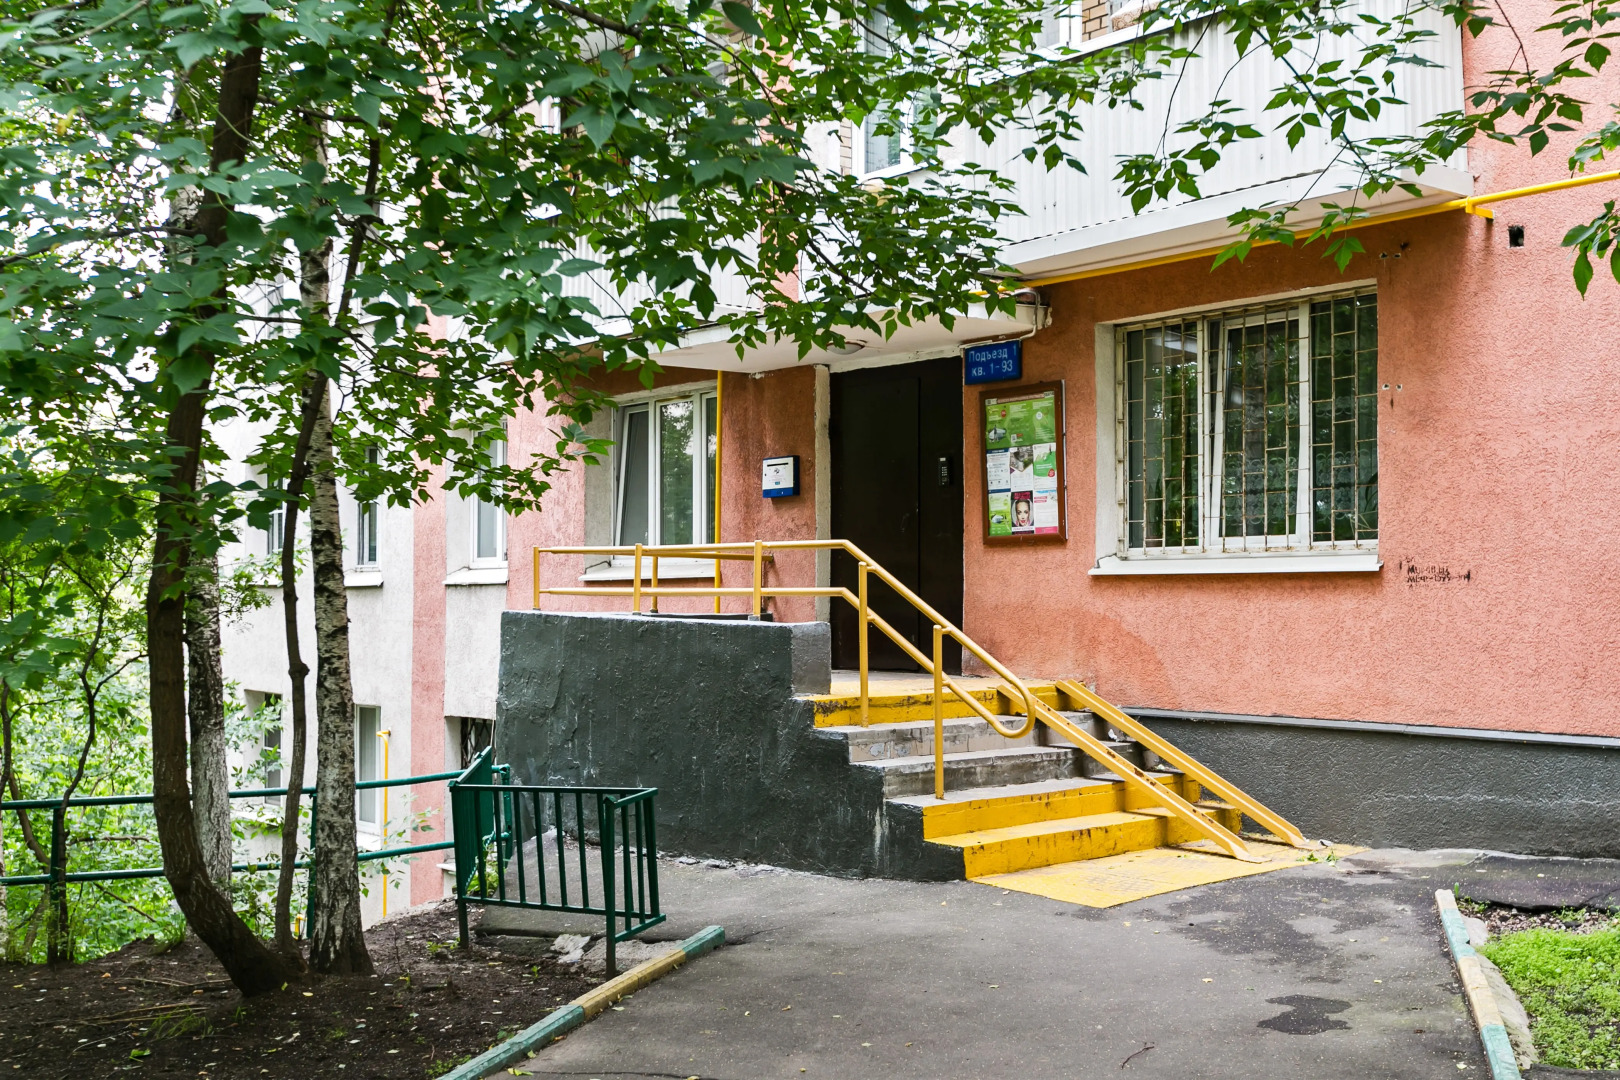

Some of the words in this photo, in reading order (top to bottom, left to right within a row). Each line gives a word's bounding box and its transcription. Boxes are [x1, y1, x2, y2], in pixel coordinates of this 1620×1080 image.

[969, 348, 1008, 362] Подъезд
[1013, 343, 1017, 356] 1
[971, 366, 986, 377] кв.
